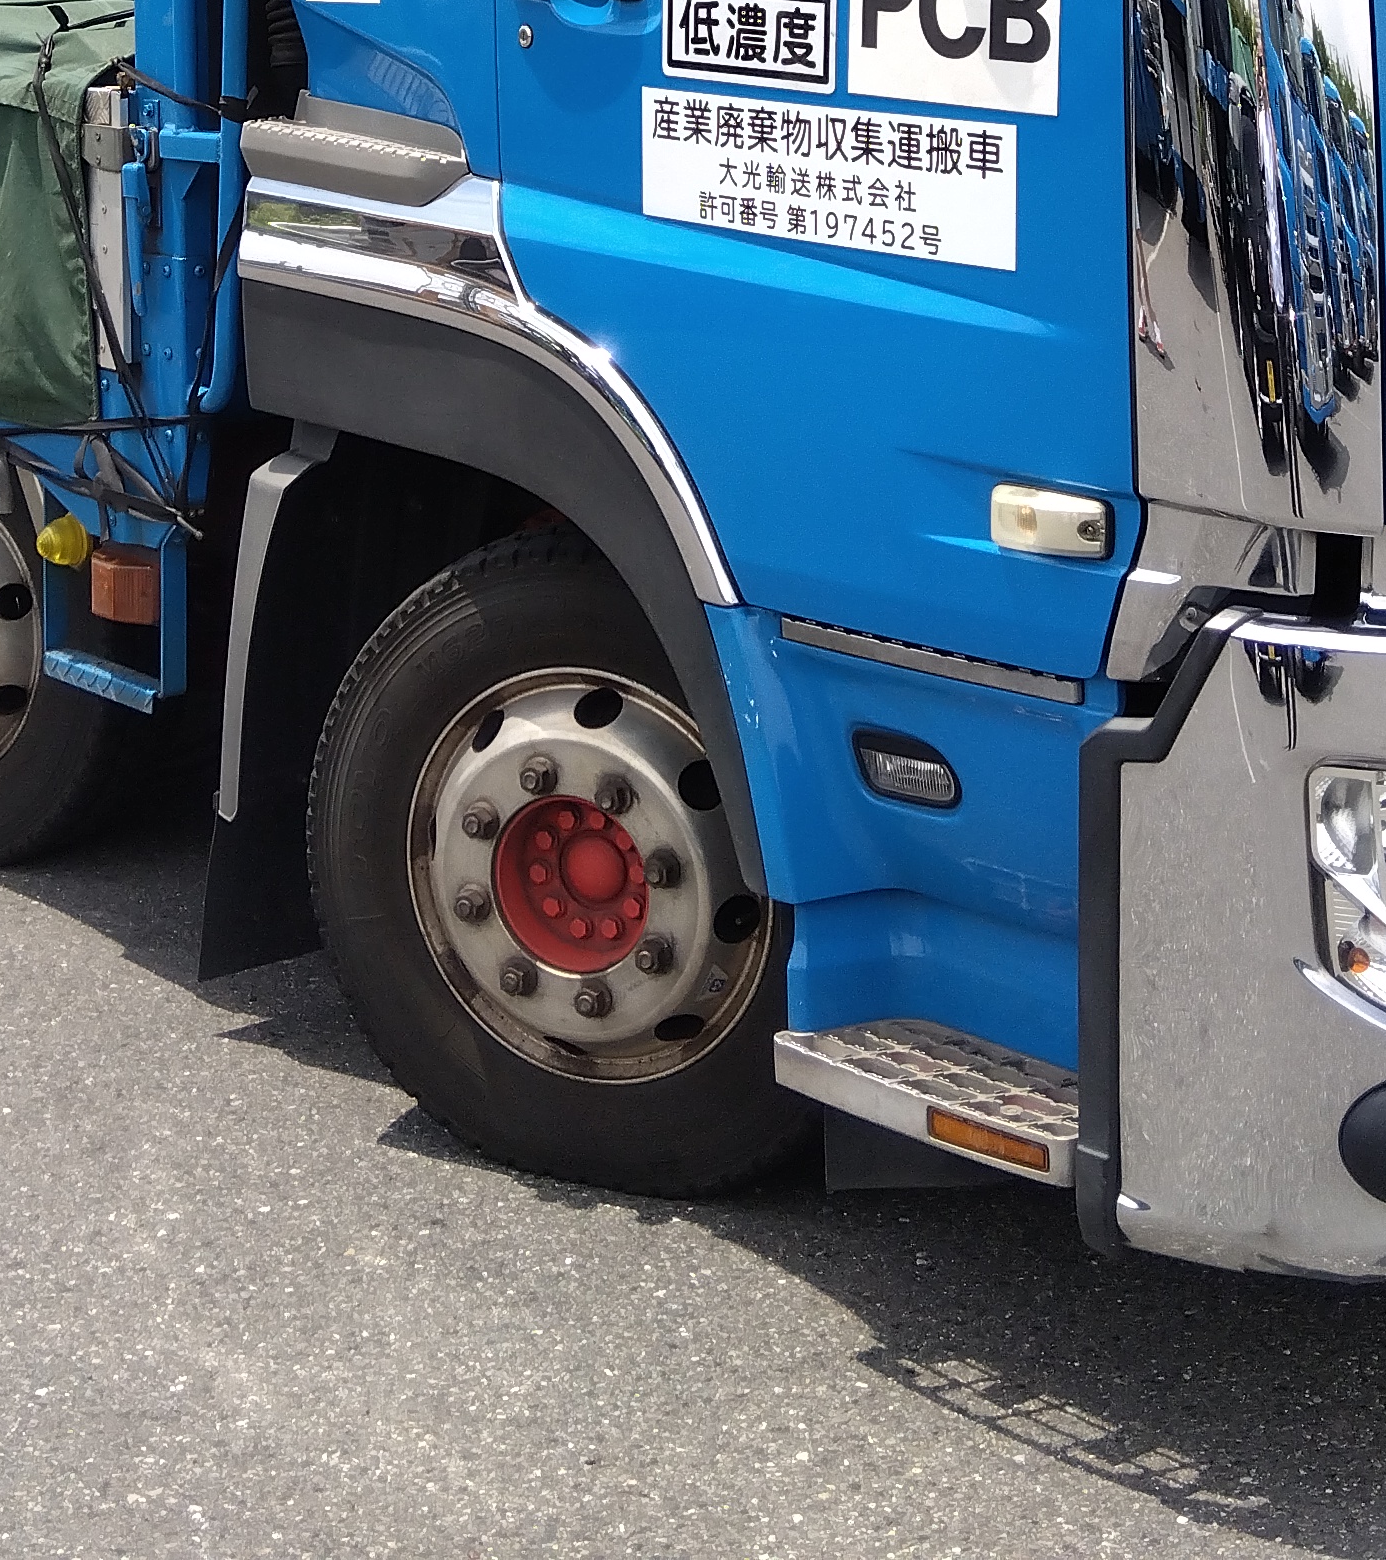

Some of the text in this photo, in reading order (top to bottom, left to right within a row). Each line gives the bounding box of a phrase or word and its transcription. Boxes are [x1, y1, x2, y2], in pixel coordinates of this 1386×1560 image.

[652, 96, 1004, 180] 産業廃棄物収集運搬車
[719, 157, 917, 212] 大光輸送株式会社
